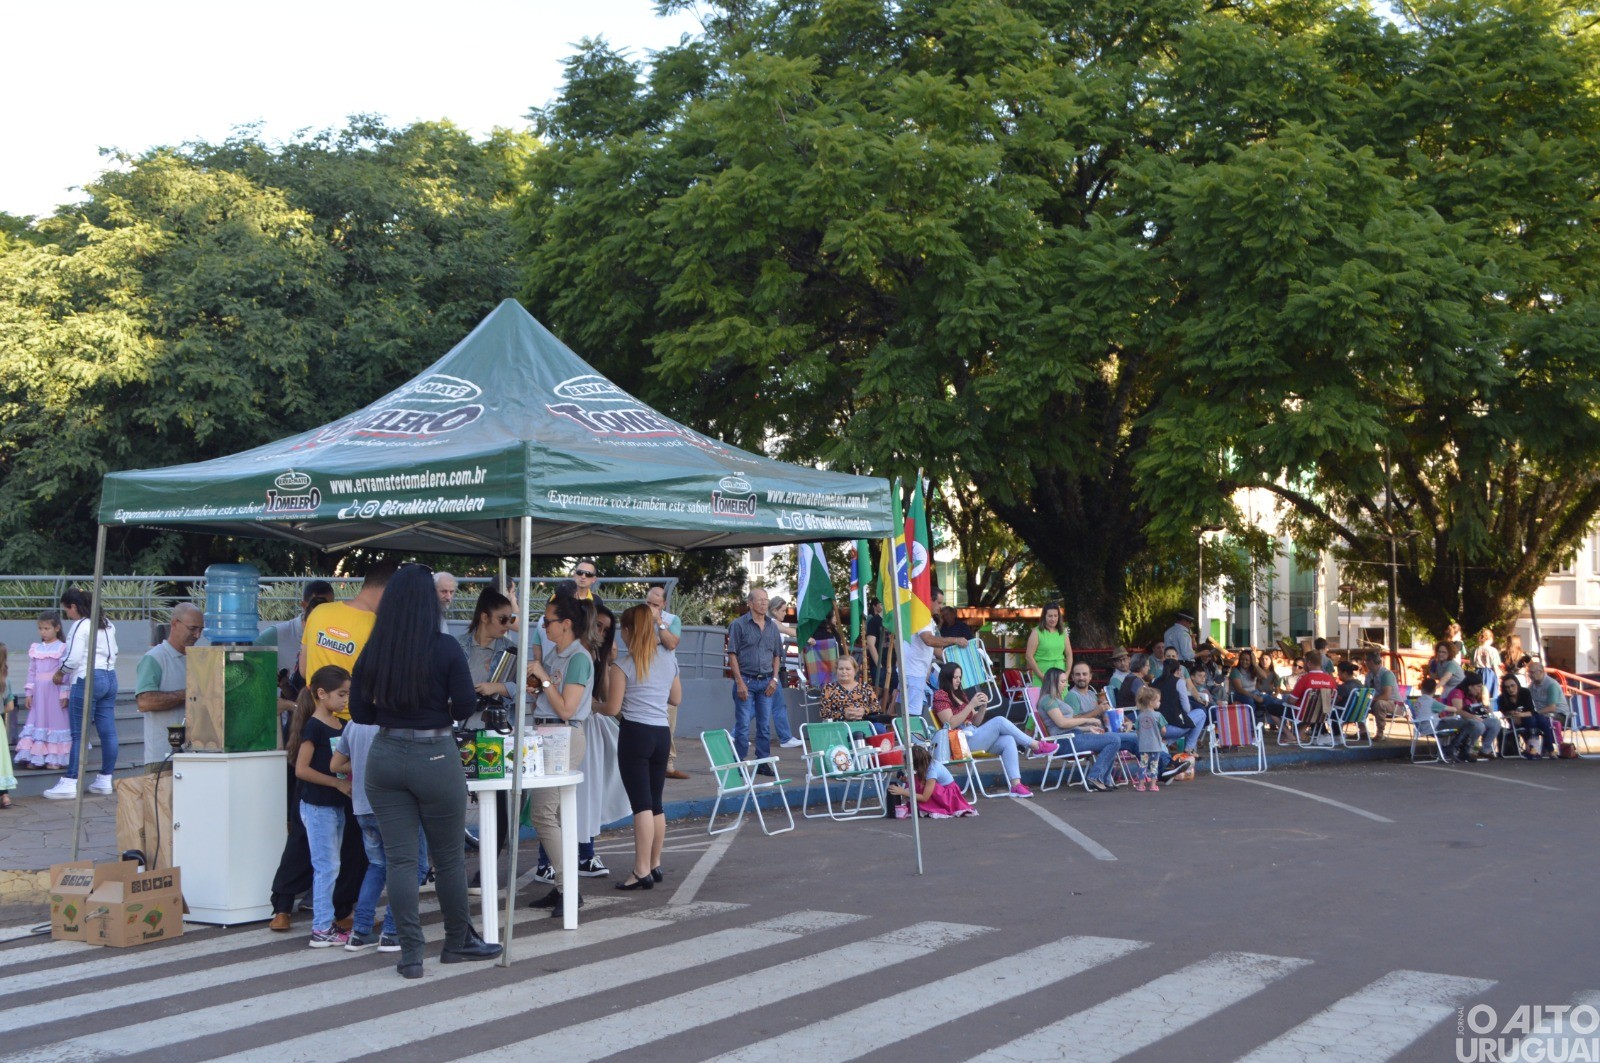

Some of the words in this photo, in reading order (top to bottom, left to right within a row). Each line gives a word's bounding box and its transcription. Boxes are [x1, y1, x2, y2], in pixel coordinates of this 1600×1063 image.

[330, 465, 487, 494] www.ervamatetomelero.com.br
[266, 487, 322, 512] TOMELERO
[379, 495, 486, 517] @ErvaMateTomelero
[548, 490, 608, 509] Experimente
[611, 496, 632, 509] você
[633, 497, 667, 512] também
[669, 500, 685, 511] este
[687, 499, 711, 514] sabor!
[712, 490, 757, 517] TOMELERO
[766, 489, 869, 509] www.ervamatetomelero.com.br
[114, 508, 163, 523] Experimente
[218, 505, 237, 516] este
[238, 501, 265, 515] sabor!
[805, 512, 872, 531] @ErvaMateTomelero
[316, 631, 356, 656] TOMELERO
